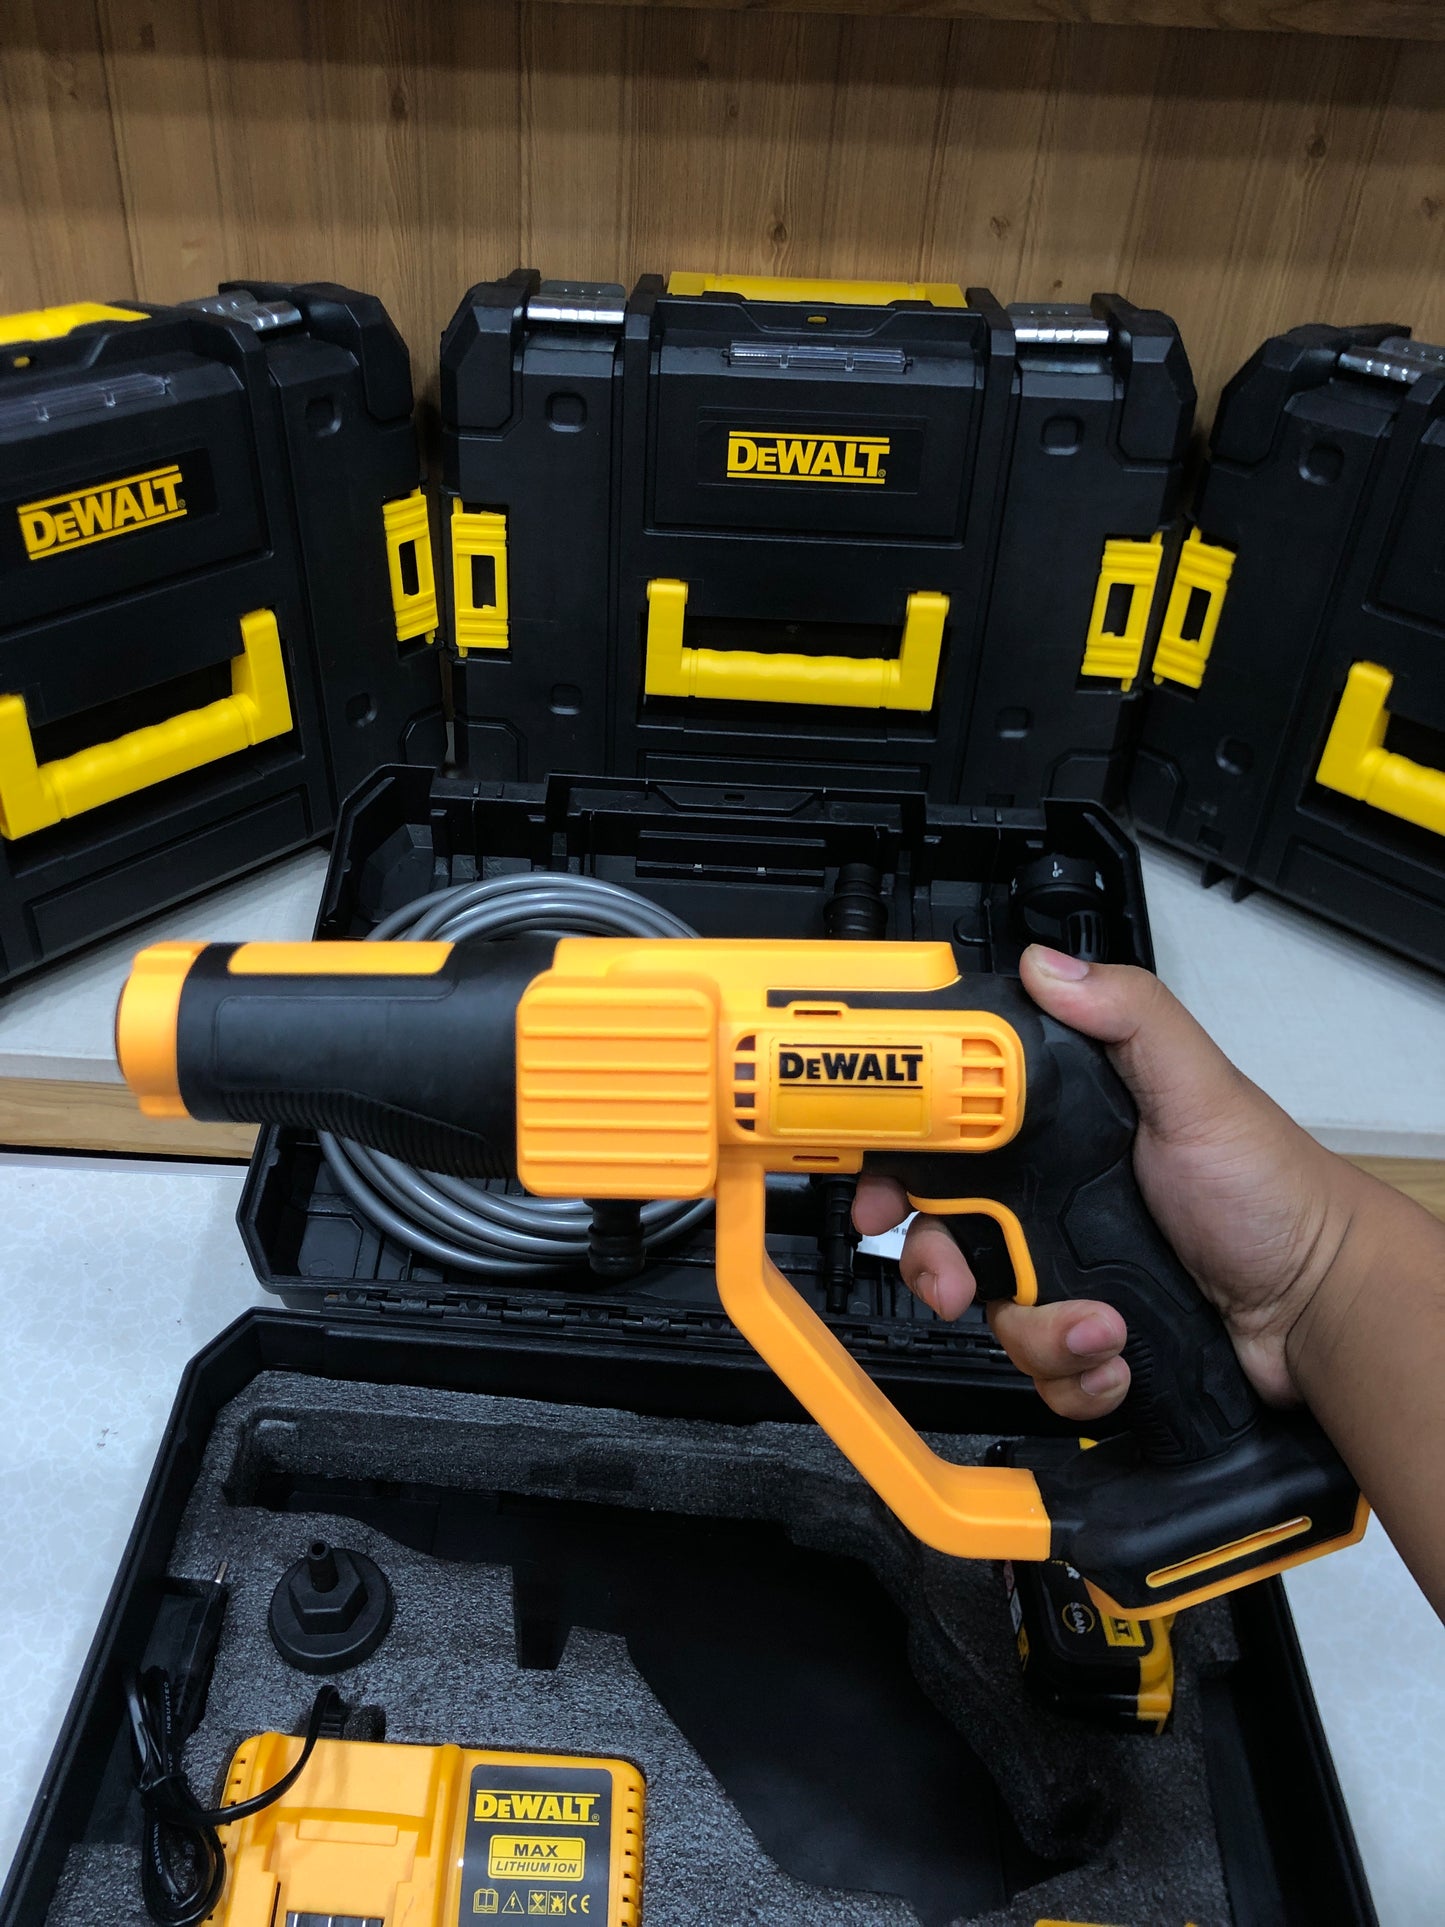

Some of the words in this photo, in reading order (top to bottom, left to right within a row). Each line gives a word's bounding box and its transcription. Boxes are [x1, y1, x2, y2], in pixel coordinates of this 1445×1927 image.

[514, 1843, 558, 1857] MAX
[496, 1860, 550, 1873] LITHIUM
[553, 1863, 577, 1874] ION
